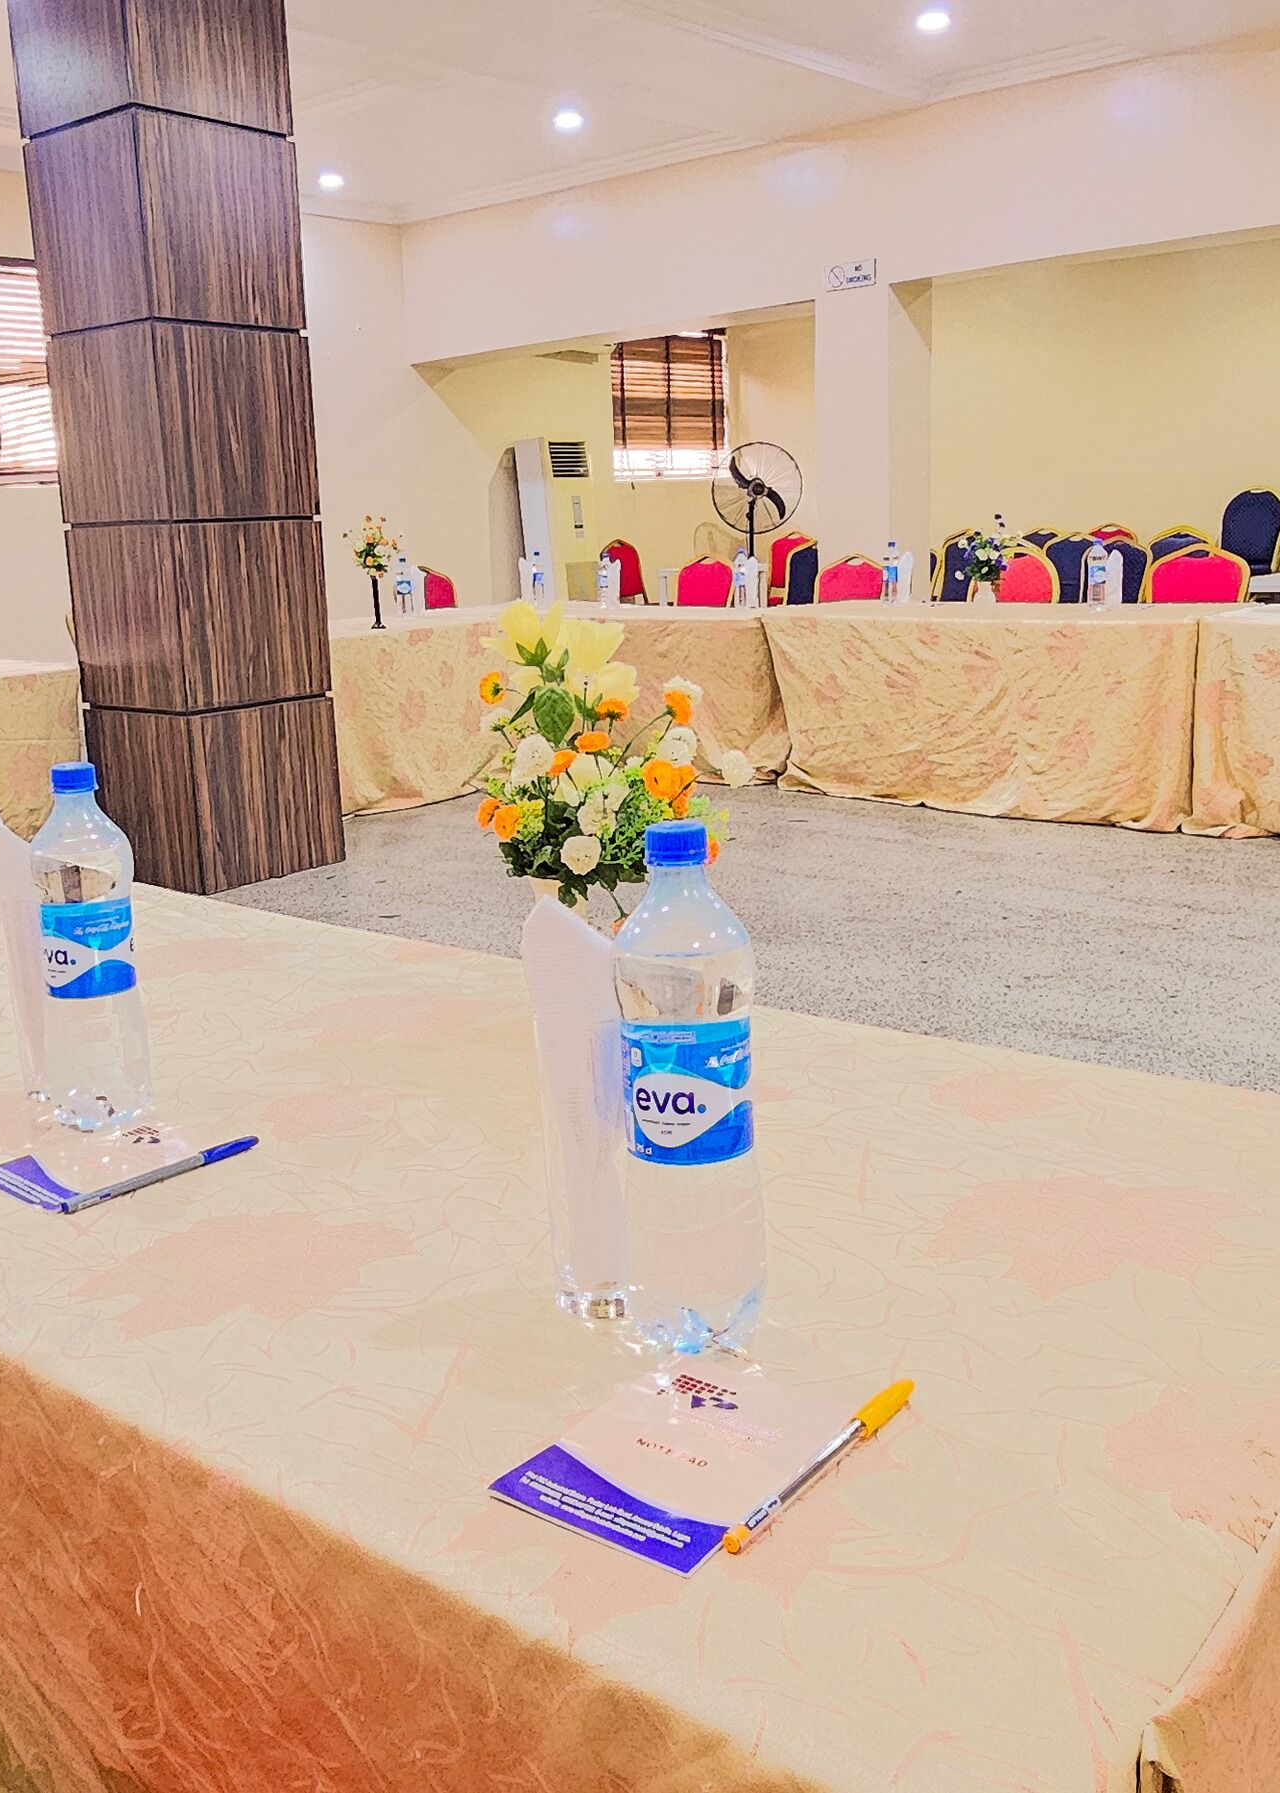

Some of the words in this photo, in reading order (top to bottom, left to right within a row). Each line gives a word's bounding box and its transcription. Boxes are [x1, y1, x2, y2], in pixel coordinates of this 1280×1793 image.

[43, 948, 76, 965] va.
[635, 1087, 707, 1115] eva.
[635, 1437, 673, 1456] NOTE
